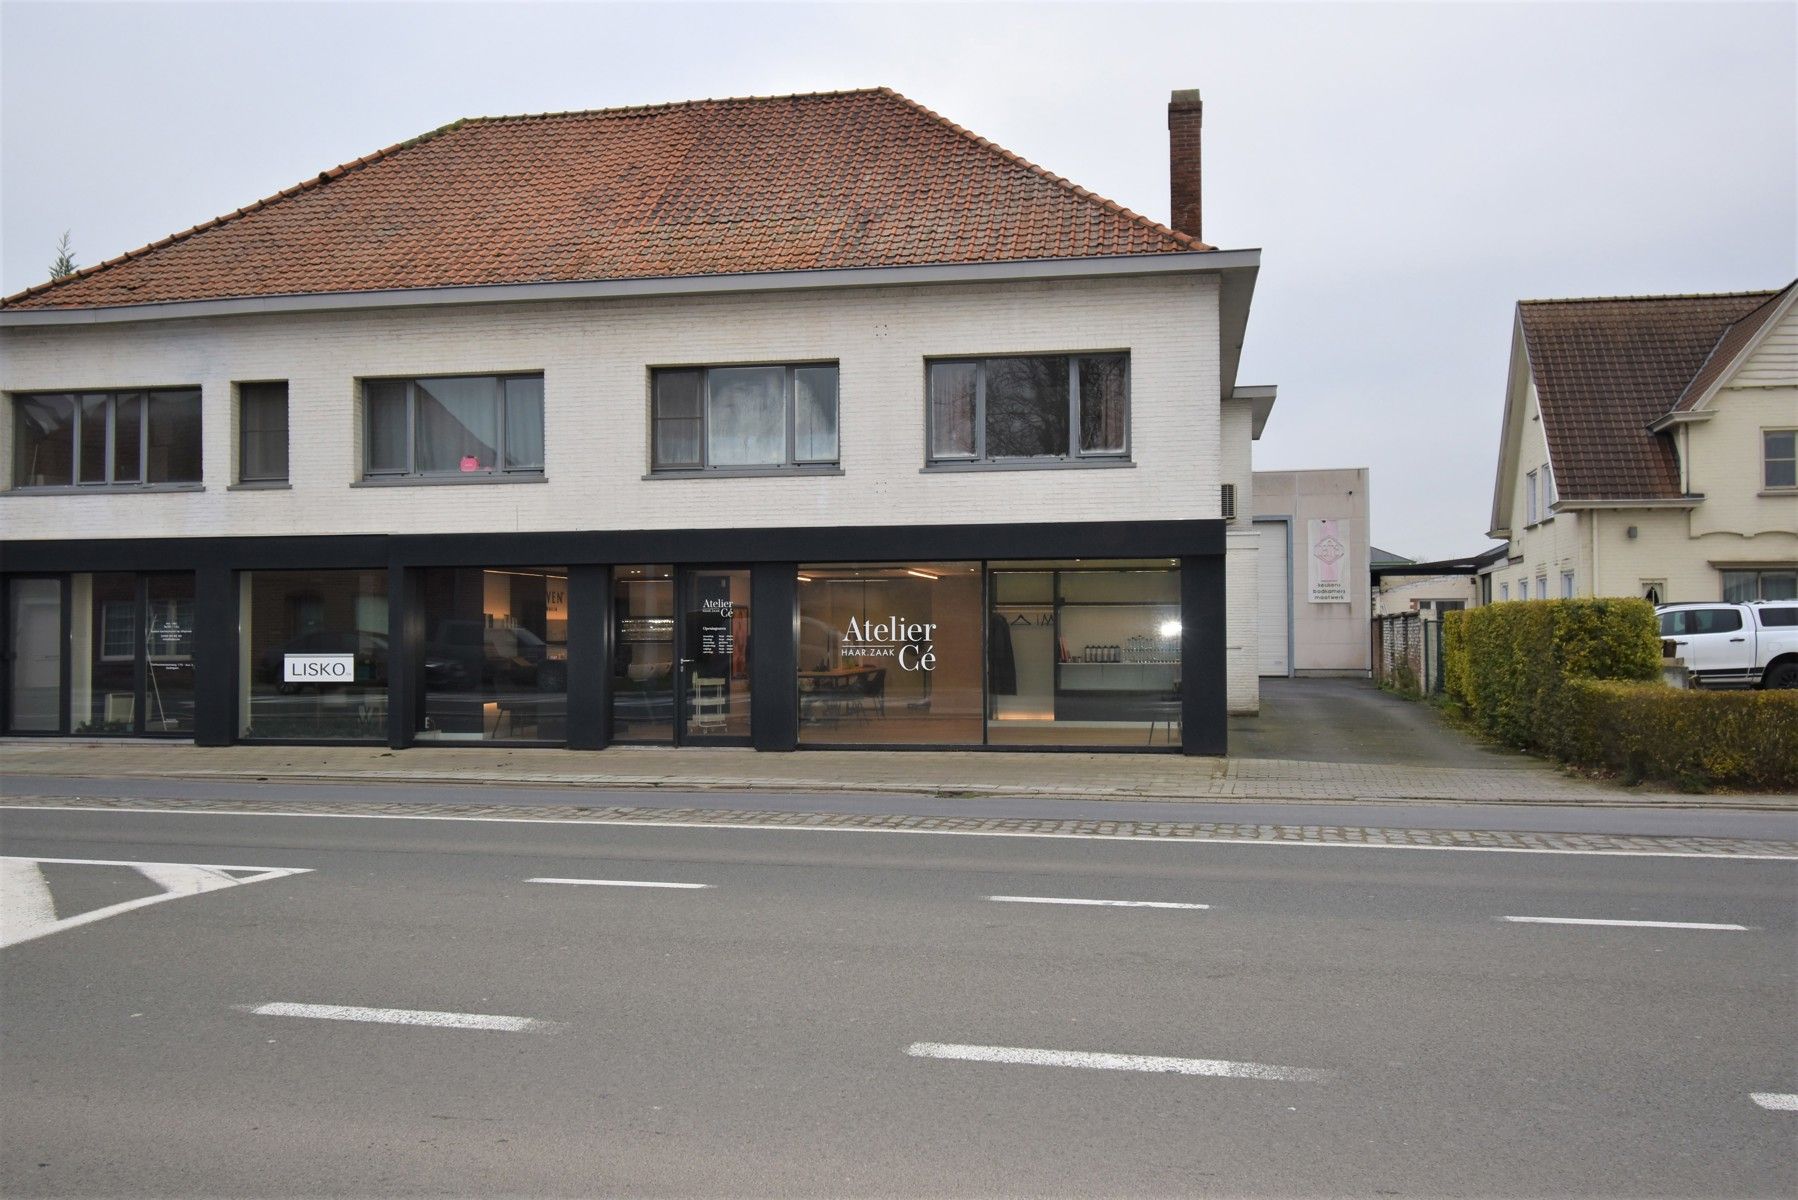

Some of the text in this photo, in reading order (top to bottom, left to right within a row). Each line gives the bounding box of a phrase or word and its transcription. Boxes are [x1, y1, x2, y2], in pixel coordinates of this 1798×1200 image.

[703, 598, 733, 608] Atelier
[720, 607, 733, 618] Cé
[841, 616, 937, 642] Atelier
[898, 644, 936, 671] Cé
[292, 662, 346, 677] LISKO
